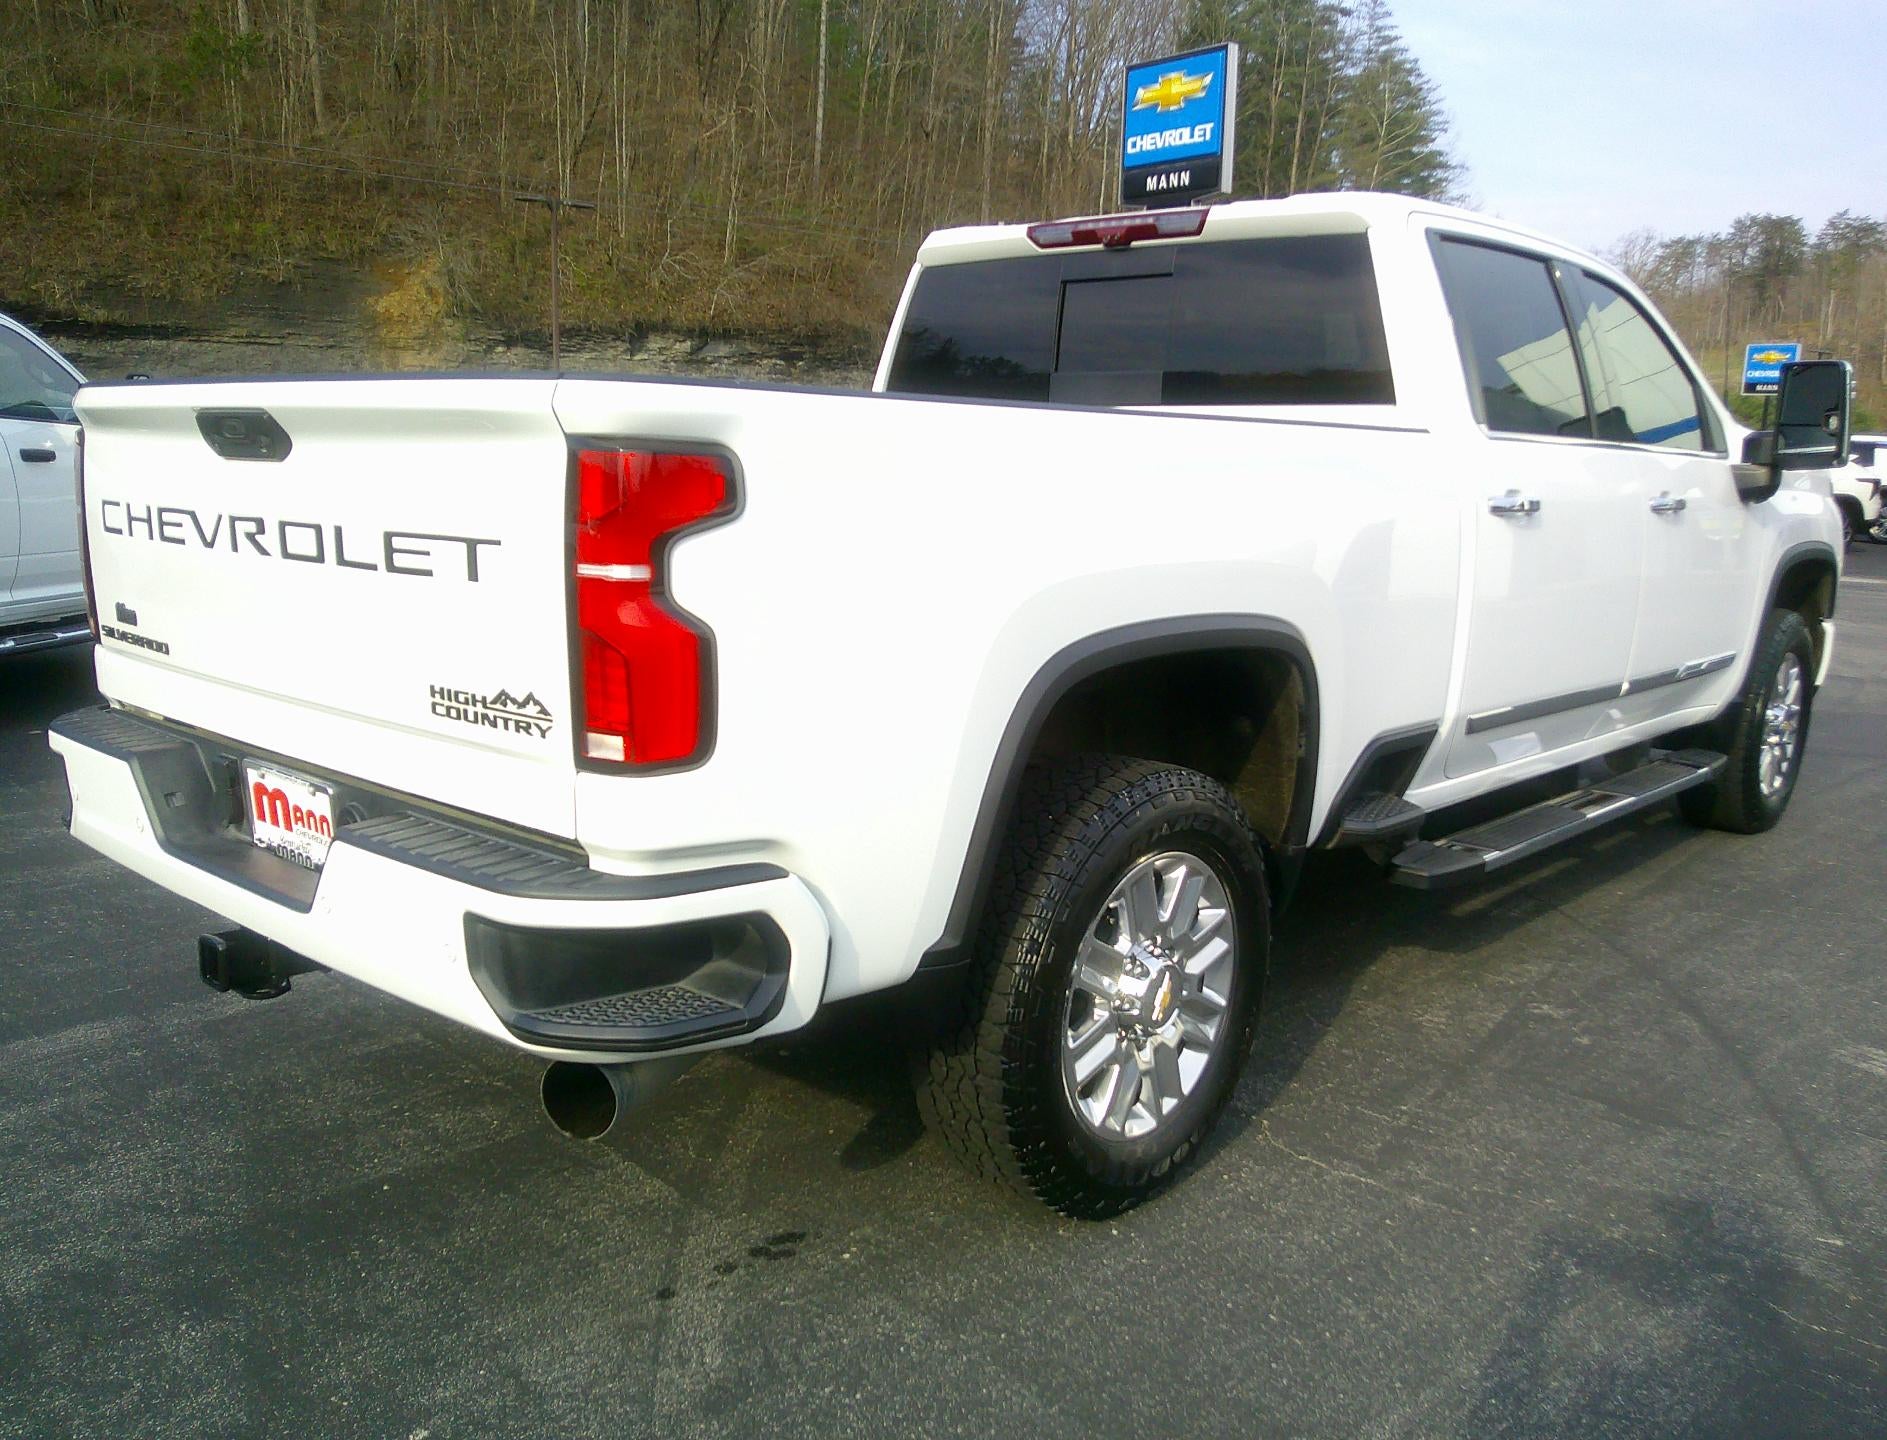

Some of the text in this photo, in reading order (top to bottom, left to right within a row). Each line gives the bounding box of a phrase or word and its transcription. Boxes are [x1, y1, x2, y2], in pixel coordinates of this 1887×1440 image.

[1127, 122, 1214, 154] CHEVROLET
[1146, 170, 1191, 191] MANN
[101, 499, 501, 582] CHEVROLET
[429, 684, 487, 709] HIGH
[431, 701, 552, 739] COUNTRY
